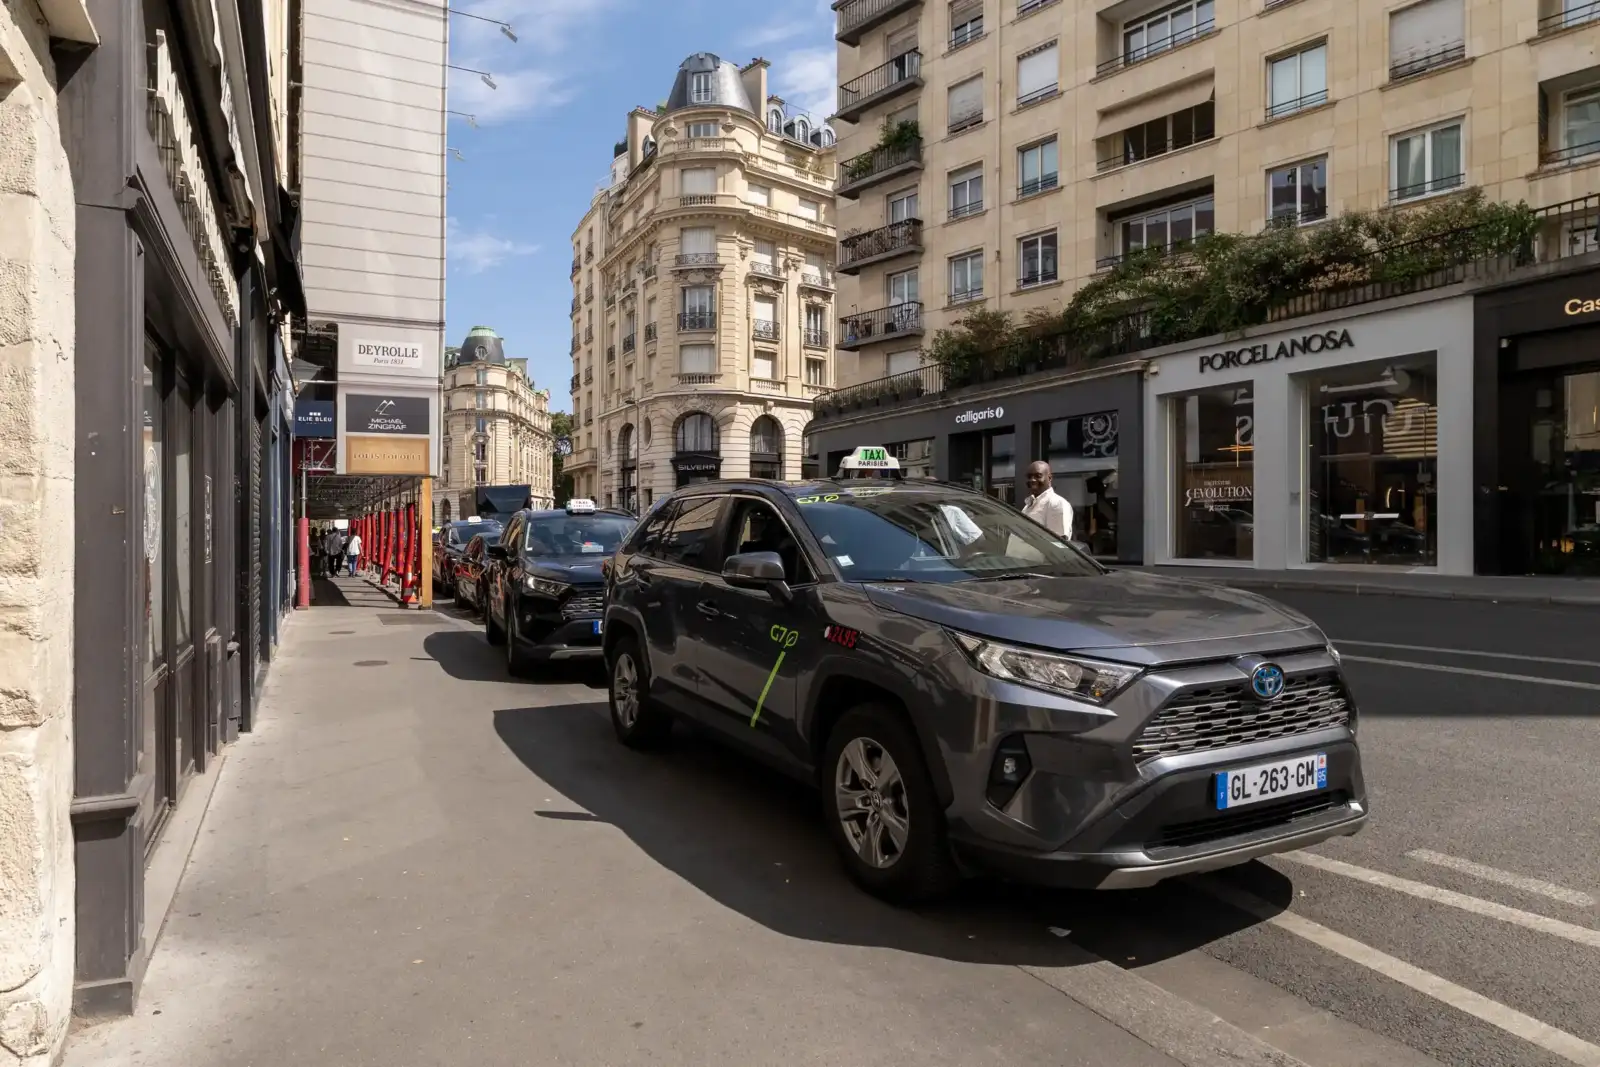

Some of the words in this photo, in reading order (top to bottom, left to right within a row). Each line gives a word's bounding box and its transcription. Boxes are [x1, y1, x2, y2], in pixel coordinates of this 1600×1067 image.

[358, 344, 419, 358] DEYROLLE
[1199, 328, 1355, 373] PORCELANOSA
[955, 407, 995, 424] calligaris
[863, 449, 885, 460] TAXI
[1231, 760, 1315, 801] GL-263-GM
